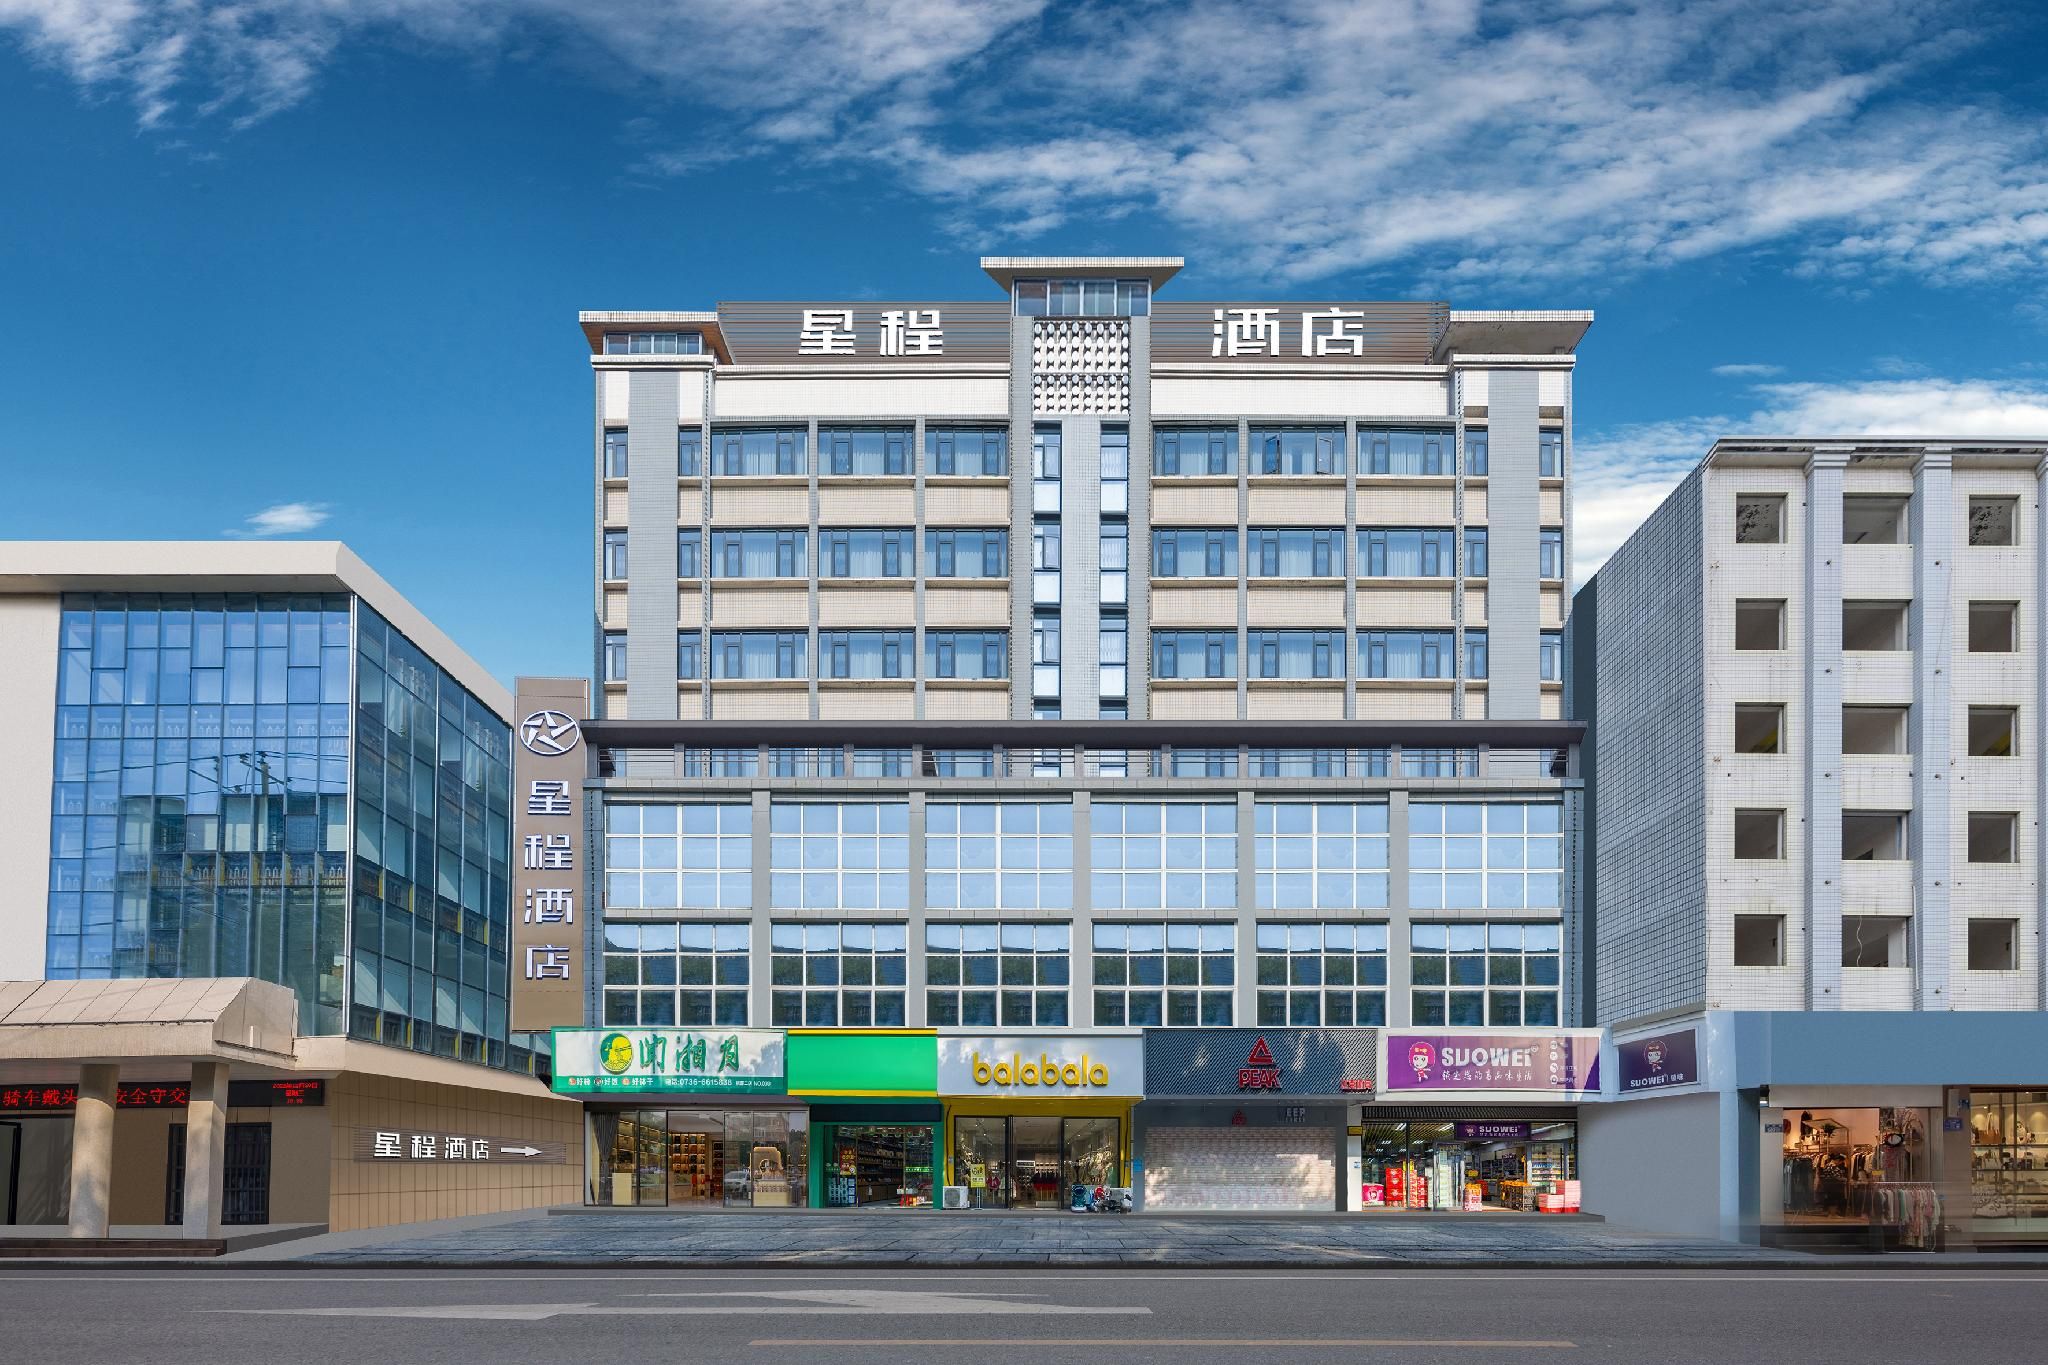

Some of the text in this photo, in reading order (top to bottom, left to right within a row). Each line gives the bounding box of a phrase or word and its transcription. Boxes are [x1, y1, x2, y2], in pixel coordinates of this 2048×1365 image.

[798, 307, 1366, 357] 星程 酒店
[524, 780, 573, 980] 星程酒店
[973, 1051, 1109, 1086] balabala
[1238, 1068, 1281, 1088] PEAK
[115, 1087, 190, 1105] 安全守交
[374, 1132, 489, 1160] 星程酒店
